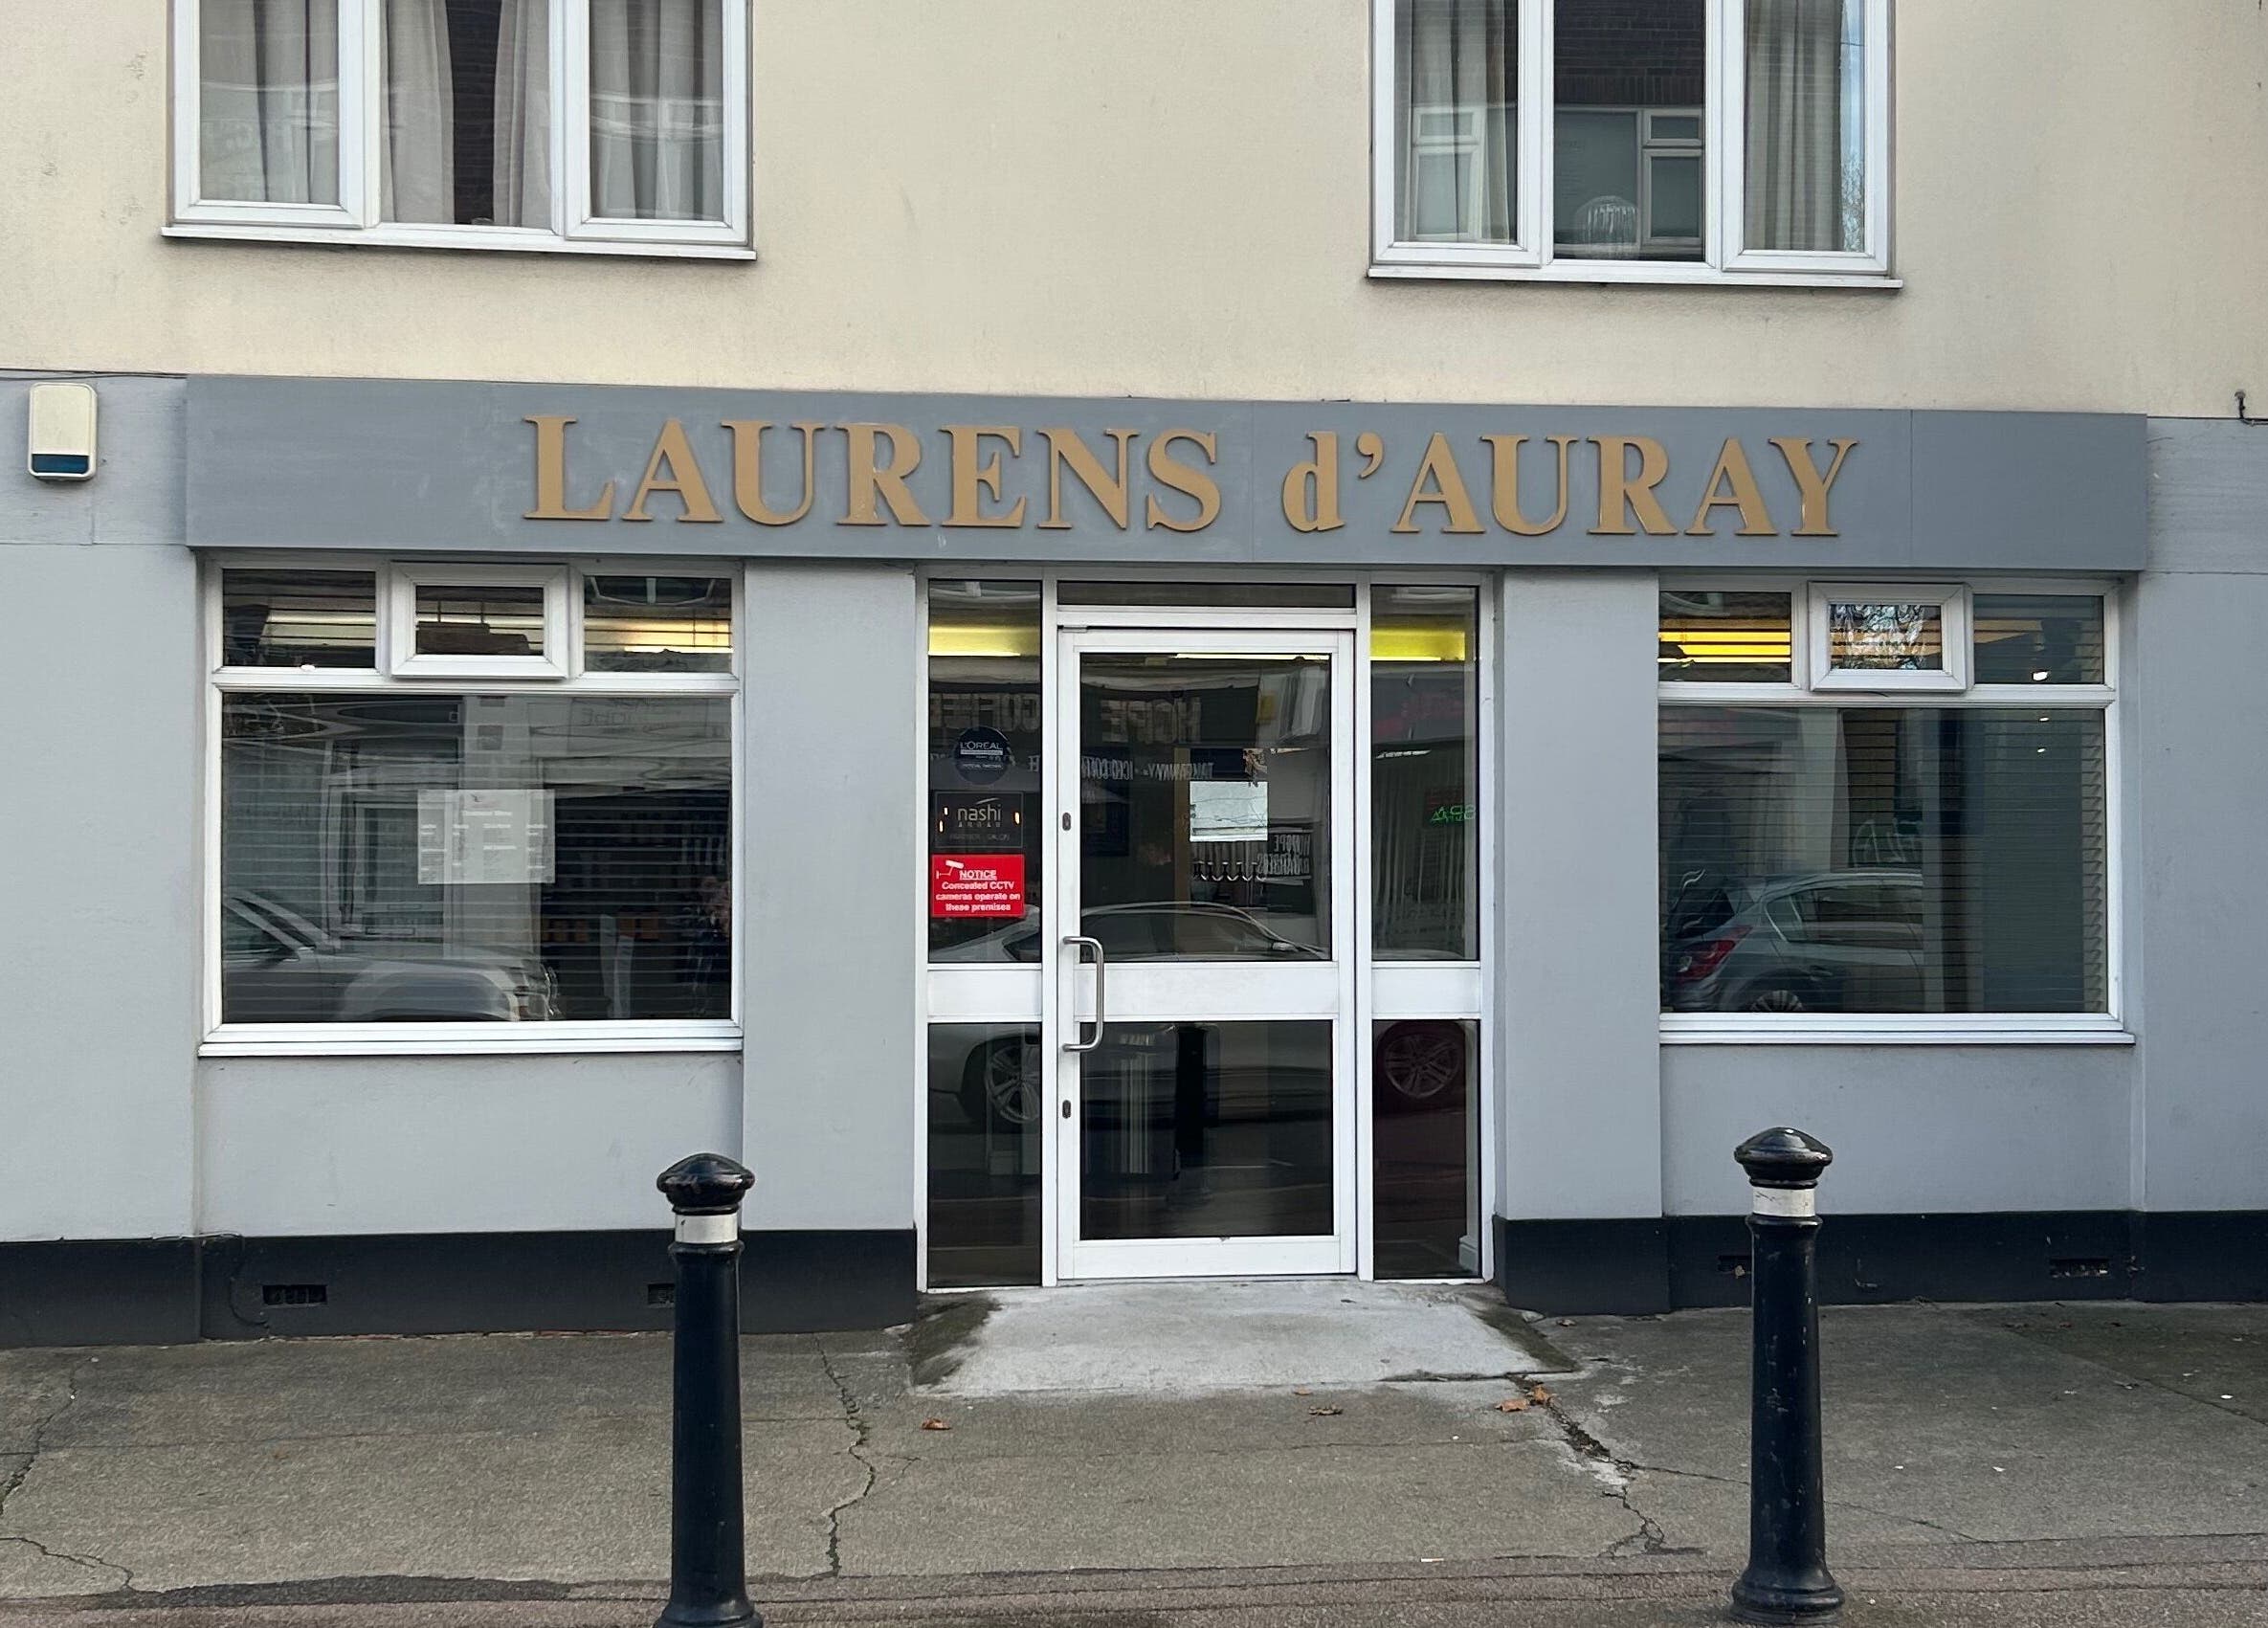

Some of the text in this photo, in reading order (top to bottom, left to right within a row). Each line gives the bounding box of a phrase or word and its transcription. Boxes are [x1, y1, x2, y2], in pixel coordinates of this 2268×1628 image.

[523, 414, 1223, 532] LAURENS
[957, 803, 1002, 821] nashi
[959, 869, 997, 881] NOTICE
[942, 881, 1015, 891] Concealed CCTV
[935, 891, 1021, 903] cameras operate on
[945, 903, 1012, 913] these premises
